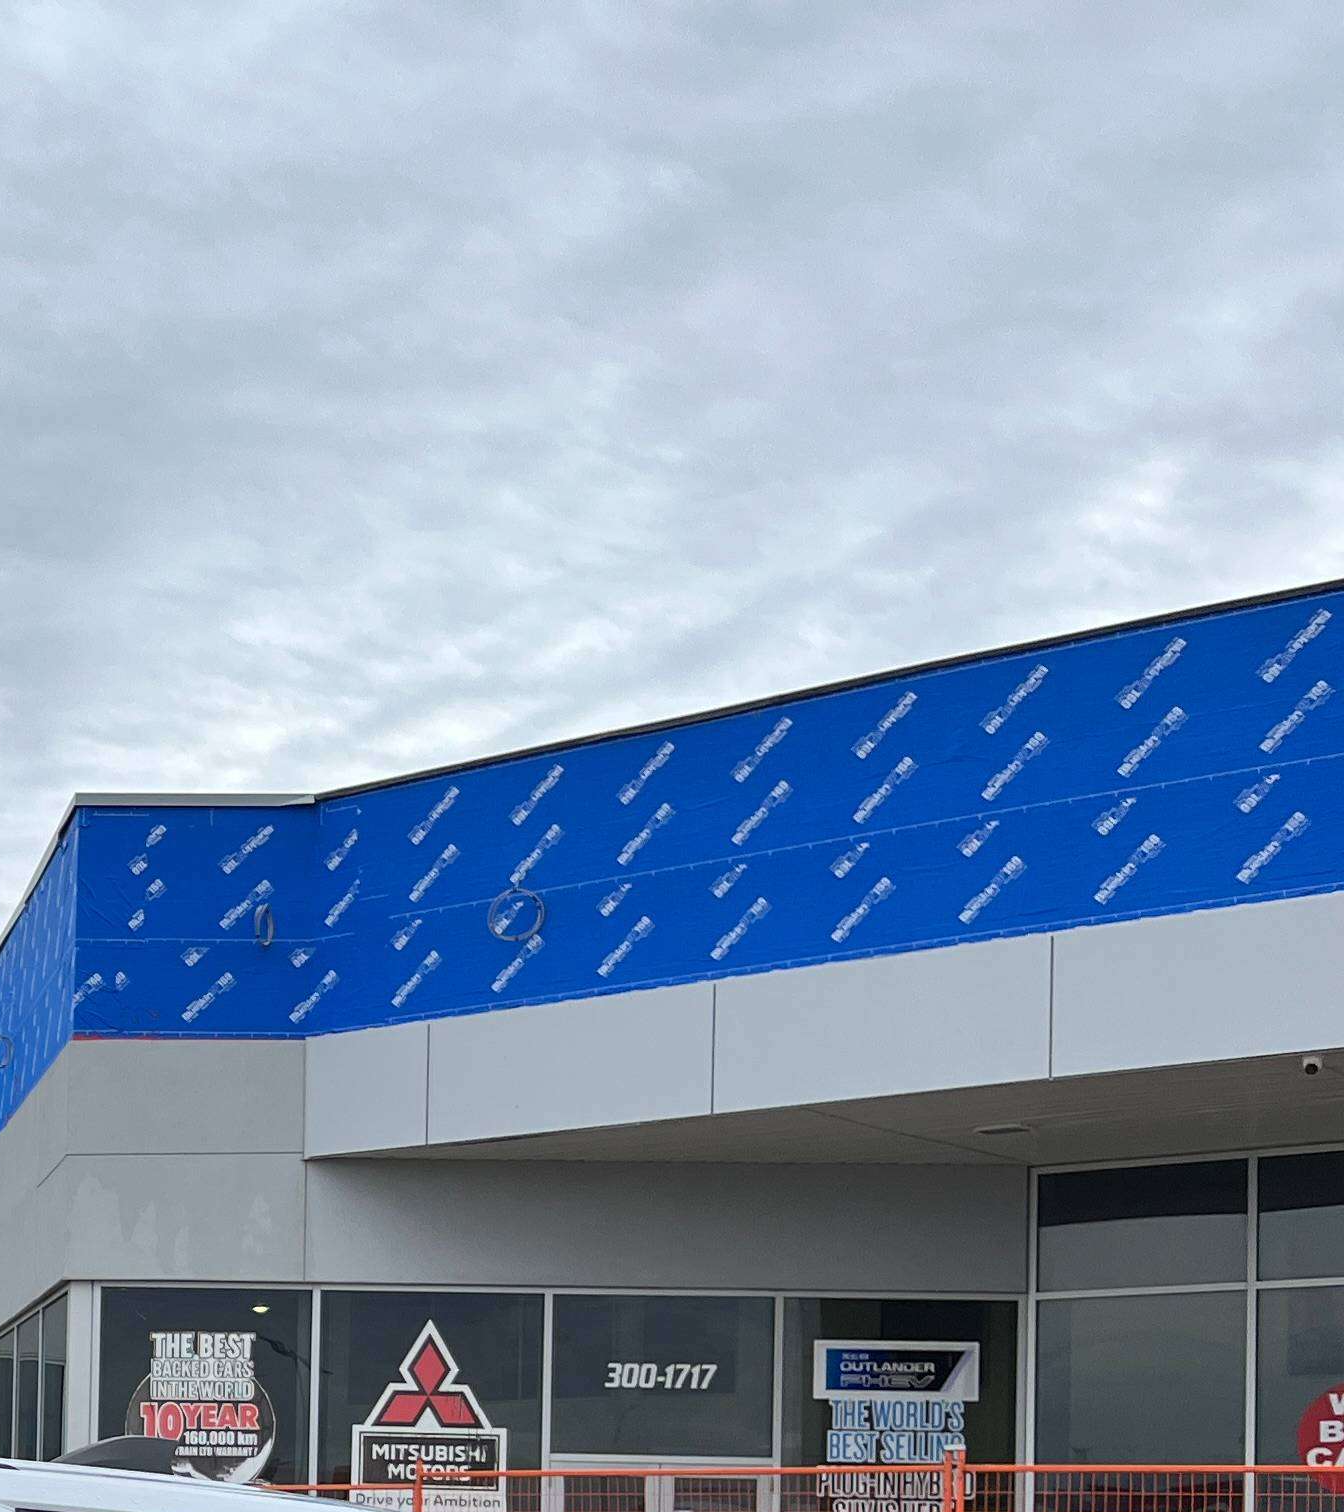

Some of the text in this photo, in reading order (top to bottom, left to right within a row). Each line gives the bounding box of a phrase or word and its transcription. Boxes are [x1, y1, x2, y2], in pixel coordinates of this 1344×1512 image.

[151, 1332, 255, 1359] THE BEST
[152, 1360, 254, 1379] BACKED CARS
[604, 1362, 718, 1389] 300-1717
[839, 1361, 936, 1373] OUTLANDER
[198, 1380, 254, 1400] WORLD
[839, 1374, 937, 1388] PHEV
[140, 1402, 259, 1440] 10 YEAR
[831, 1400, 964, 1430] THE WORLD'S
[237, 1431, 258, 1445] km
[827, 1431, 879, 1462] BEST
[372, 1443, 488, 1463] MITSUBISHI
[388, 1463, 472, 1482] MOTORS
[816, 1471, 977, 1499] PLUG-IN HYBD
[355, 1493, 501, 1508] Drive yor Ambition
